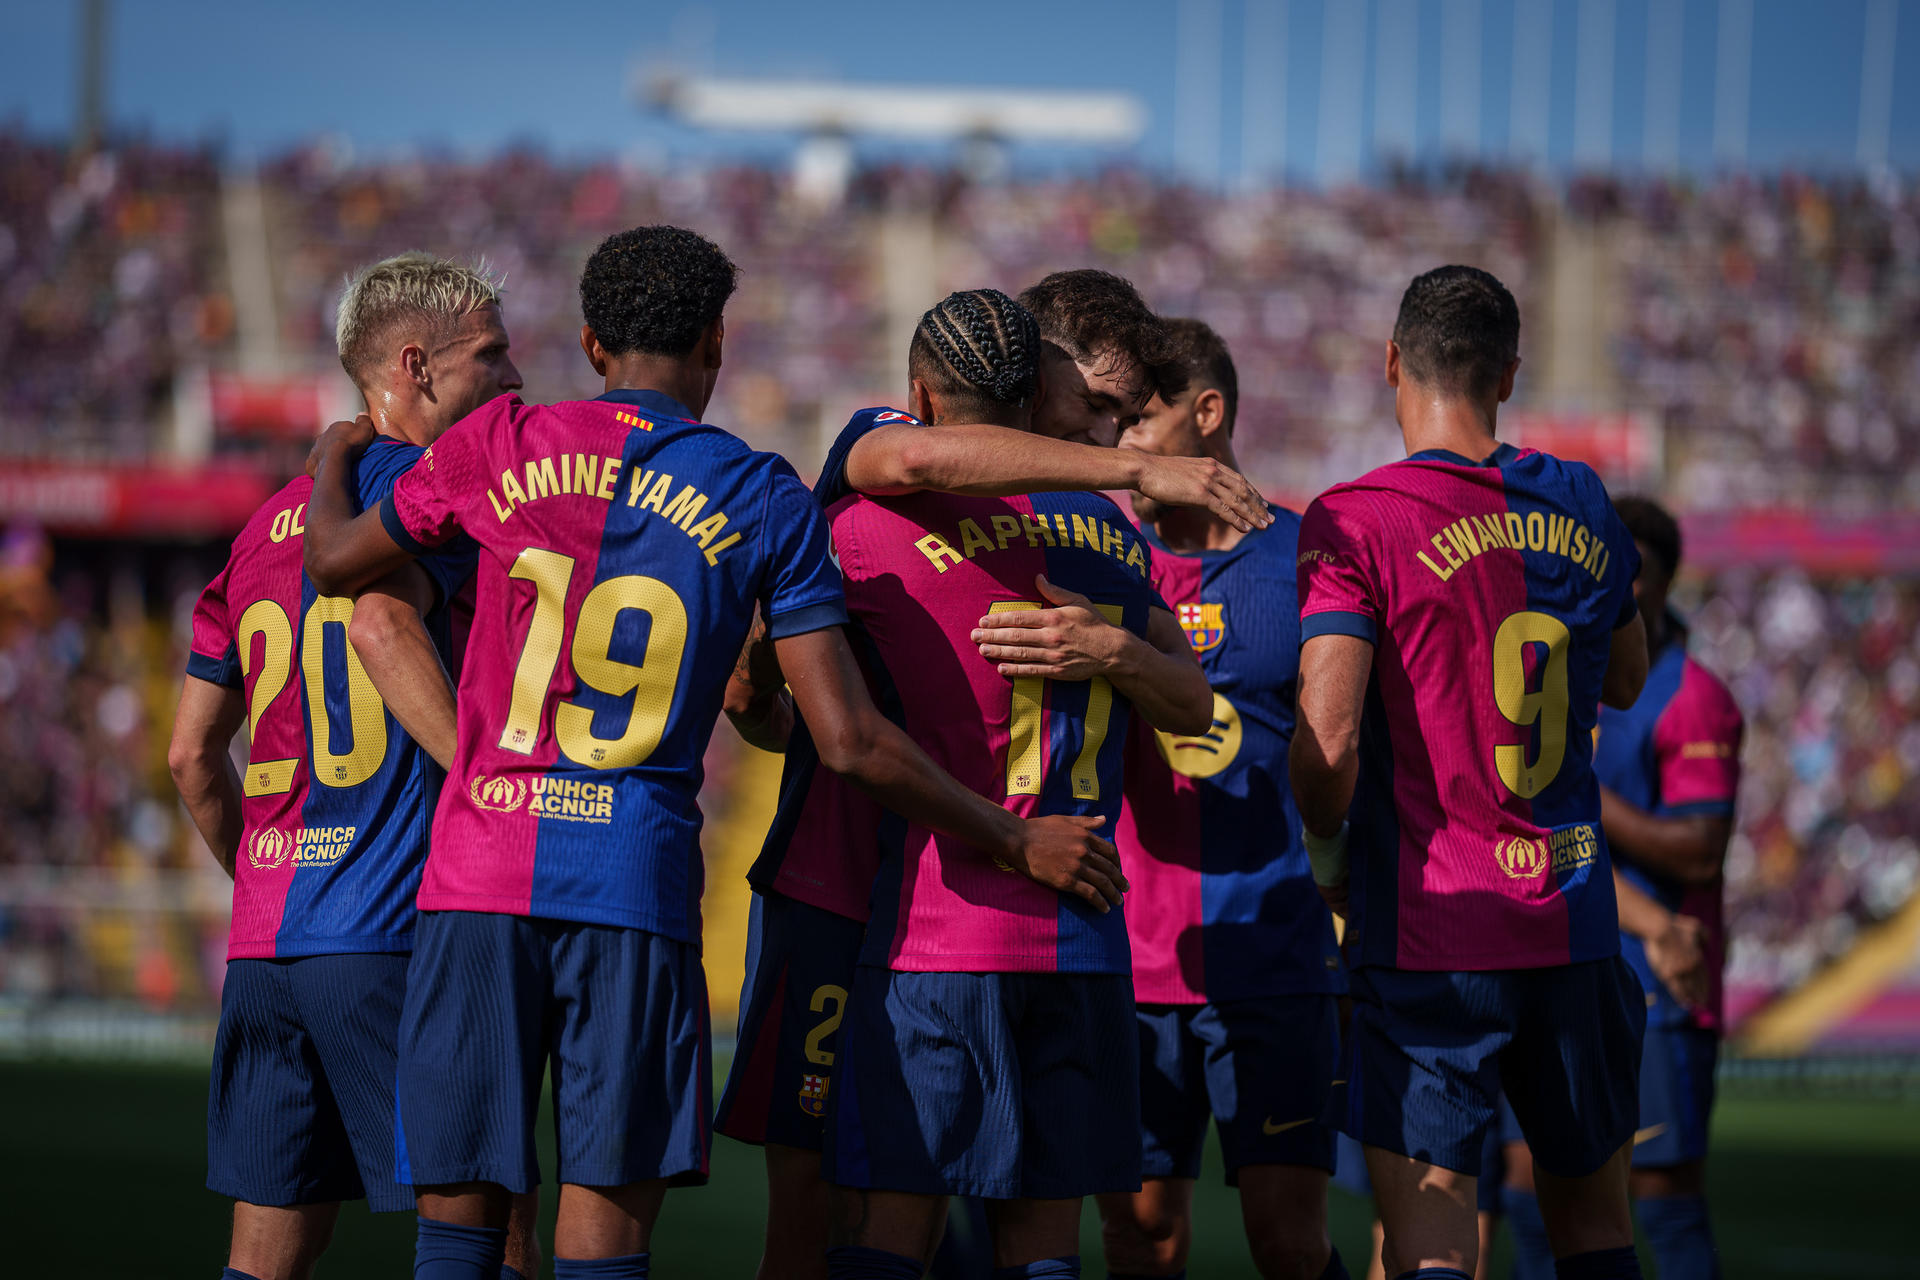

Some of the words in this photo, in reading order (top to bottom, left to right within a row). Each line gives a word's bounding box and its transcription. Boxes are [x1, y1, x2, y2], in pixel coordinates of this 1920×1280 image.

[269, 502, 307, 543] OL
[486, 453, 623, 524] LAMINE
[627, 466, 742, 567] YAMAL
[913, 513, 1146, 579] RAPHINHA
[1416, 511, 1609, 582] LEWANDOWSKI
[497, 546, 688, 770] 19
[238, 594, 388, 798] 20
[1493, 610, 1570, 799] 9
[528, 795, 612, 817] ACNUR
[531, 777, 614, 803] UNHCR
[291, 842, 350, 861] ACNUR
[295, 826, 356, 845] UNHCR
[1549, 825, 1596, 851] UNHCR
[1551, 840, 1598, 868] ACNUR
[804, 984, 849, 1066] 2
